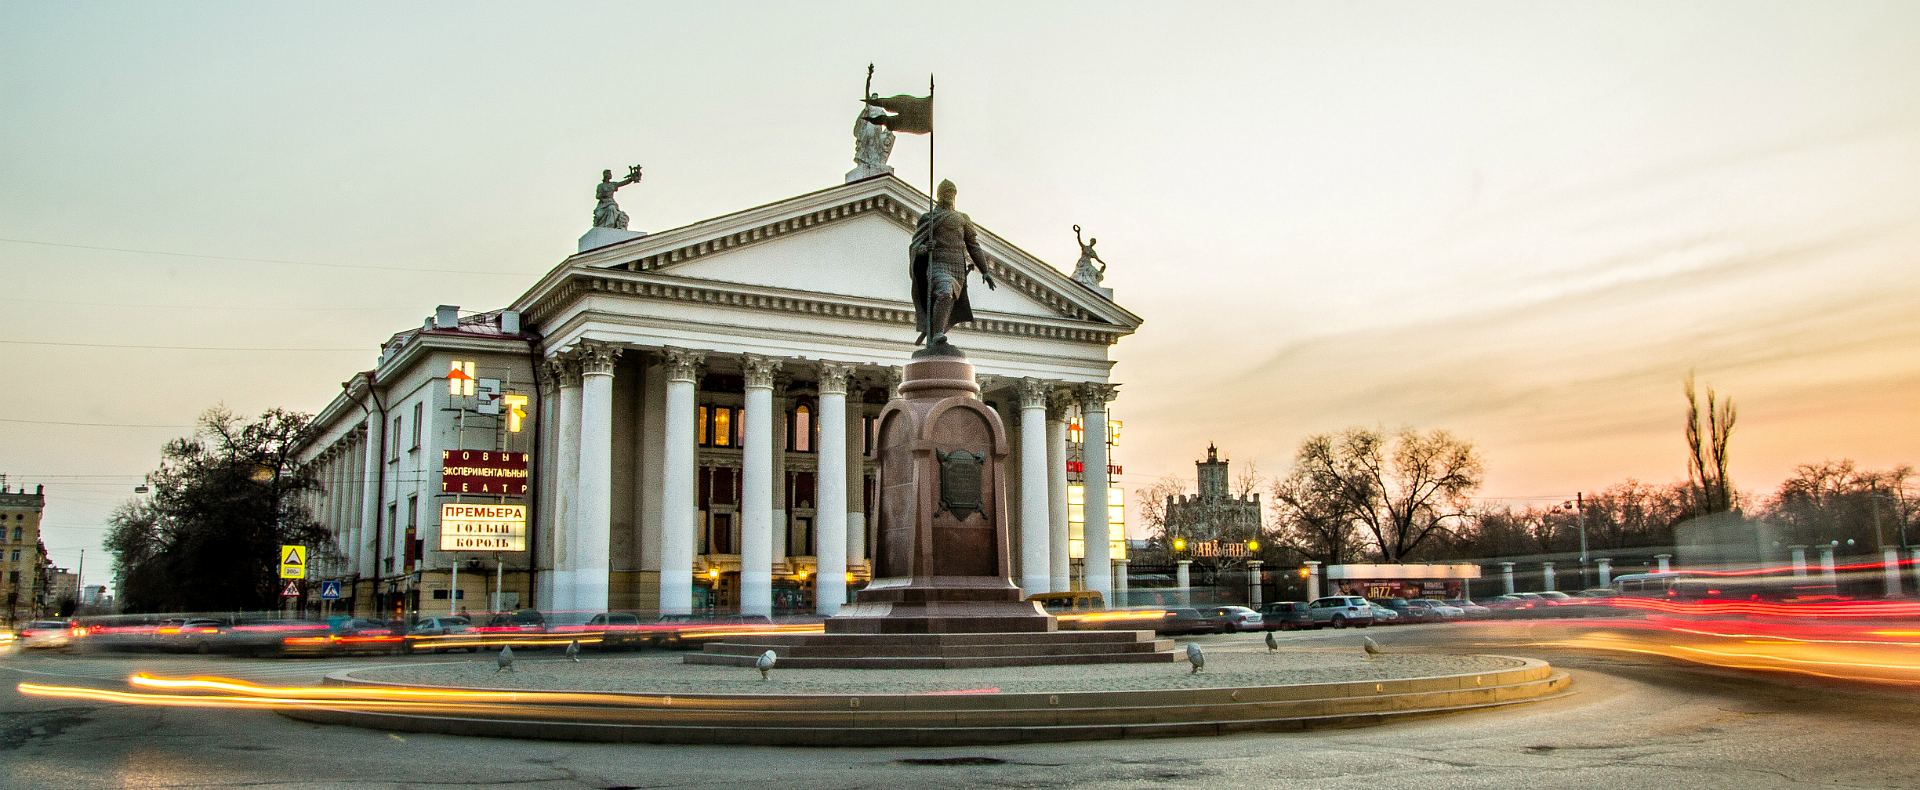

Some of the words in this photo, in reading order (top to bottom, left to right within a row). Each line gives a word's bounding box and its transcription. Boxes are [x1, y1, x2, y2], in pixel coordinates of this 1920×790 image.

[442, 451, 529, 462] НОВЫЙ
[442, 467, 528, 478] ЭКСПЕРИМЕНТАЛЬНЫЙ
[442, 482, 528, 493] ТЕАТР
[445, 506, 522, 518] ПРЕМЬЕРА
[456, 523, 509, 533] ГОЛЫЙ
[456, 538, 509, 548] КОРОЛЬ
